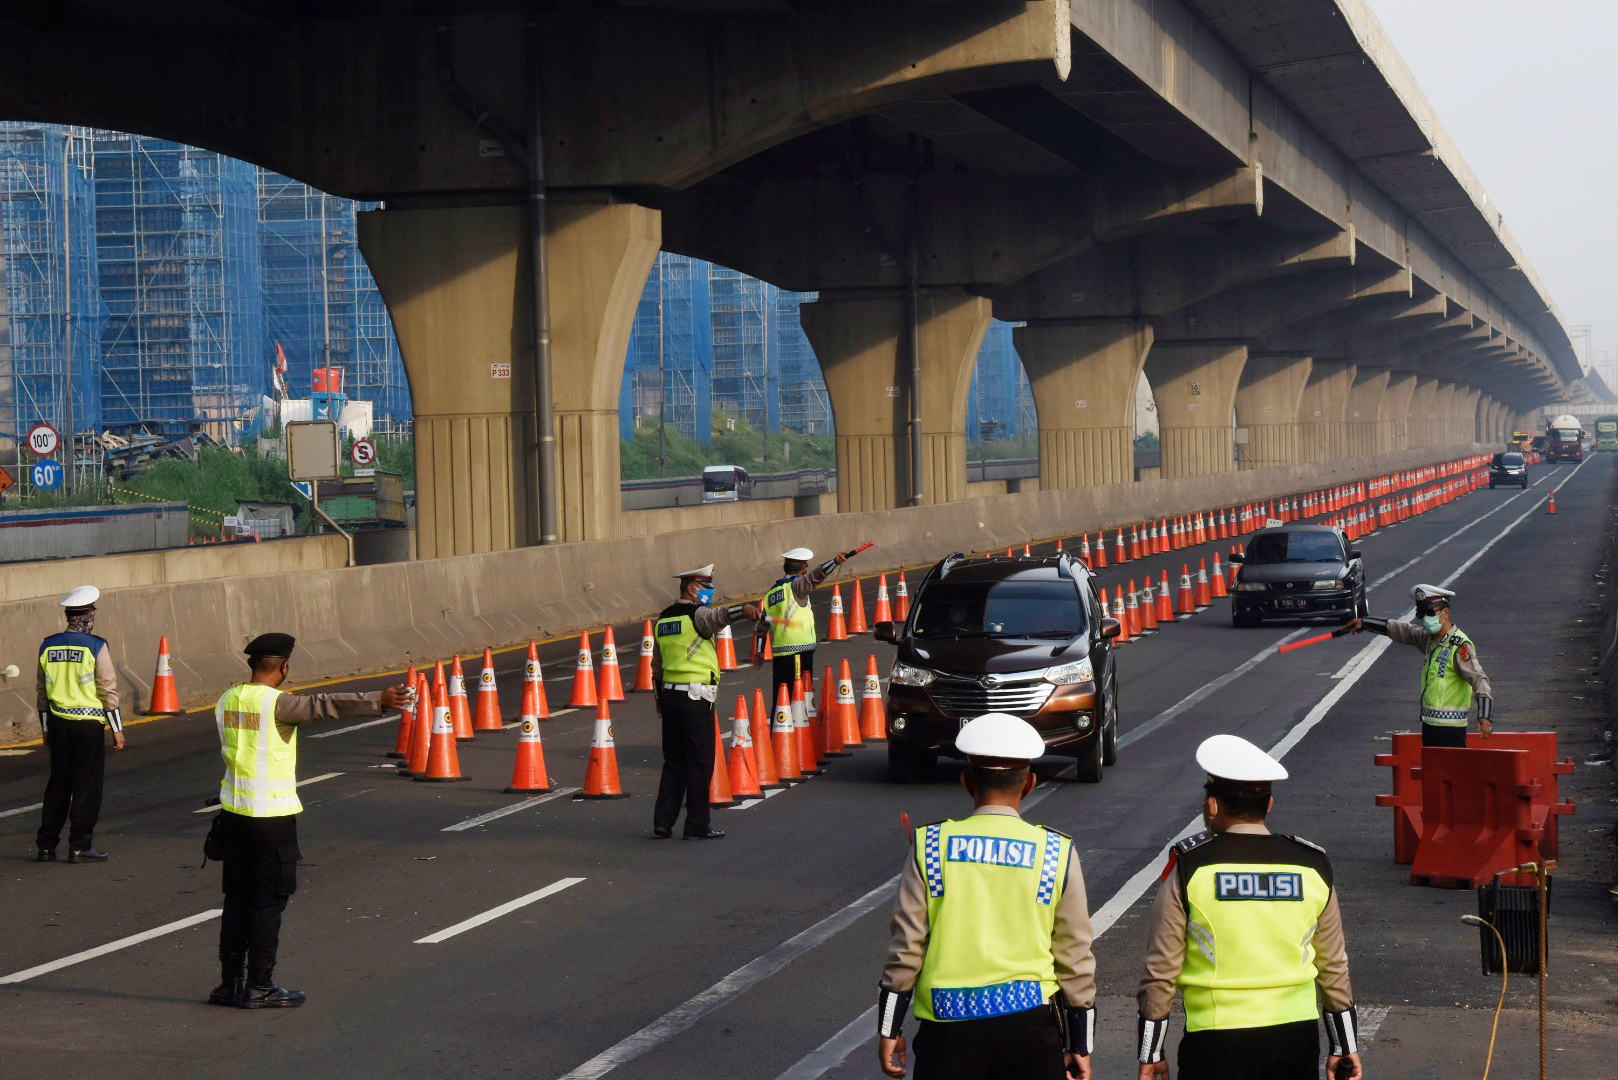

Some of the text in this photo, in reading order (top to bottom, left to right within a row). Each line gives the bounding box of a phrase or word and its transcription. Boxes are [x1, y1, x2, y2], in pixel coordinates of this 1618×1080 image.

[492, 368, 510, 377] P 333
[33, 434, 48, 448] 100
[34, 465, 54, 487] 60
[949, 837, 1034, 867] POLISI
[1219, 873, 1300, 897] POLISI
